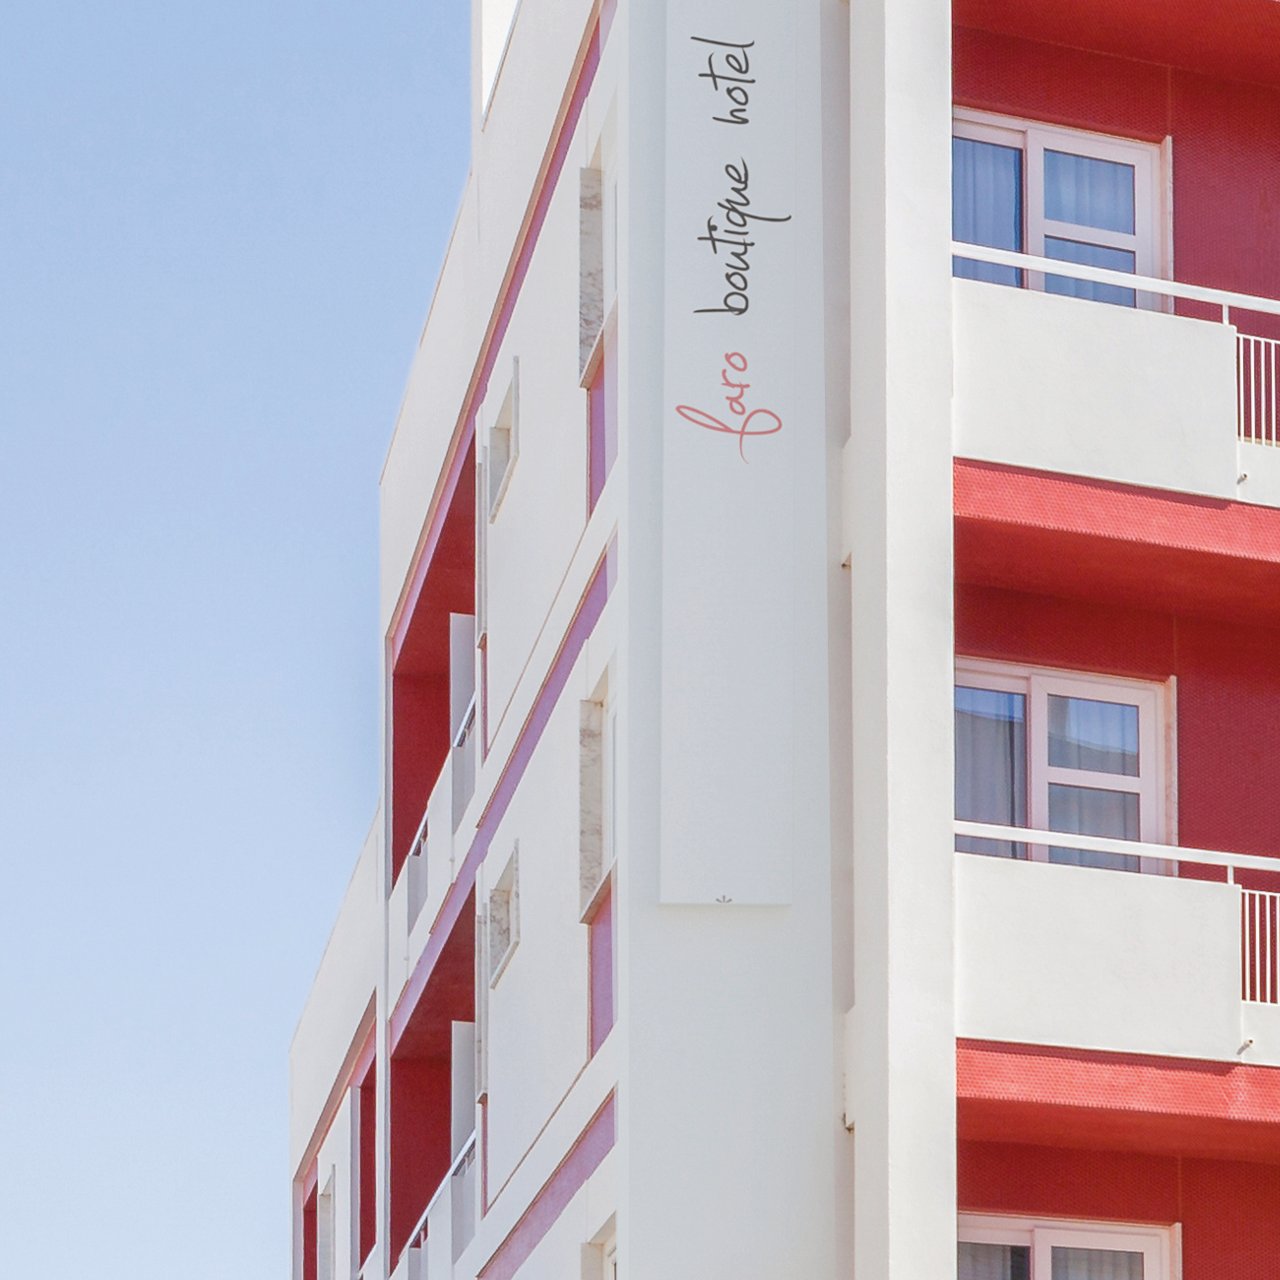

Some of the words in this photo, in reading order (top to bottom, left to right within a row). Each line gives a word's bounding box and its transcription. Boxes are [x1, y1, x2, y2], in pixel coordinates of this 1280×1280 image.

[690, 36, 756, 125] hotel
[693, 157, 792, 316] boutique
[676, 351, 783, 465] faro
